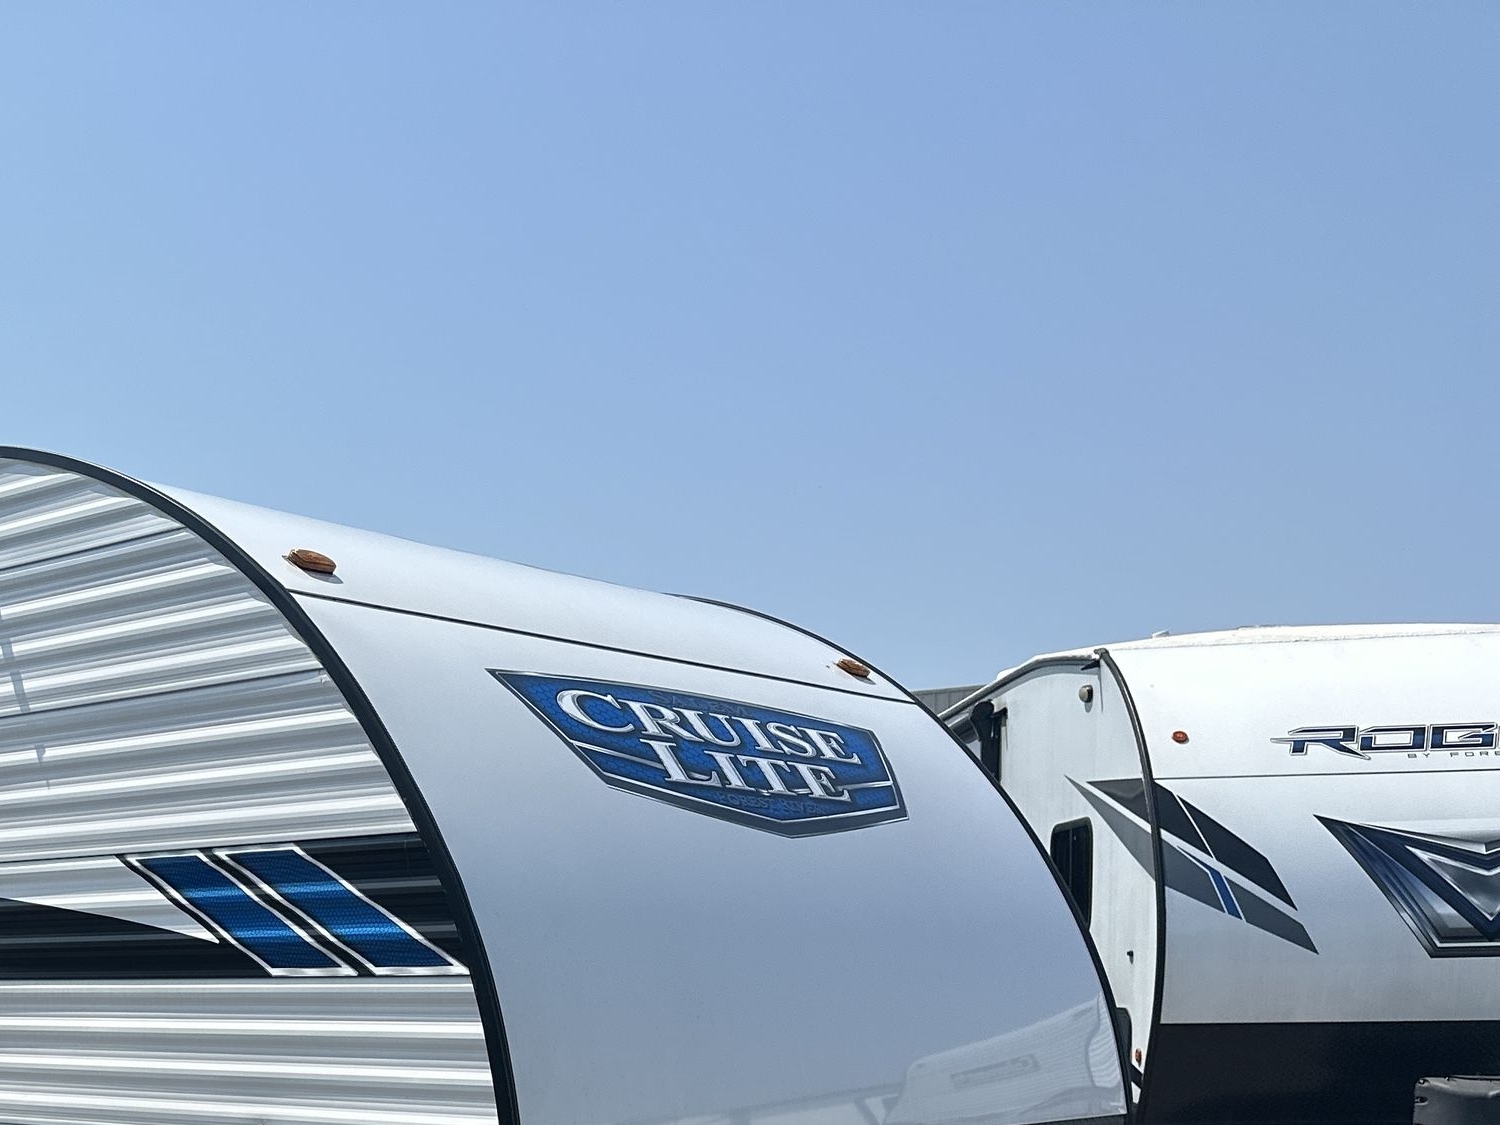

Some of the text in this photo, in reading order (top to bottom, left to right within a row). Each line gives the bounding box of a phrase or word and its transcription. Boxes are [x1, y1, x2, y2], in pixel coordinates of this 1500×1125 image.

[556, 689, 861, 765] CRUISE
[1270, 722, 1500, 761] ROG
[639, 738, 851, 802] LITE
